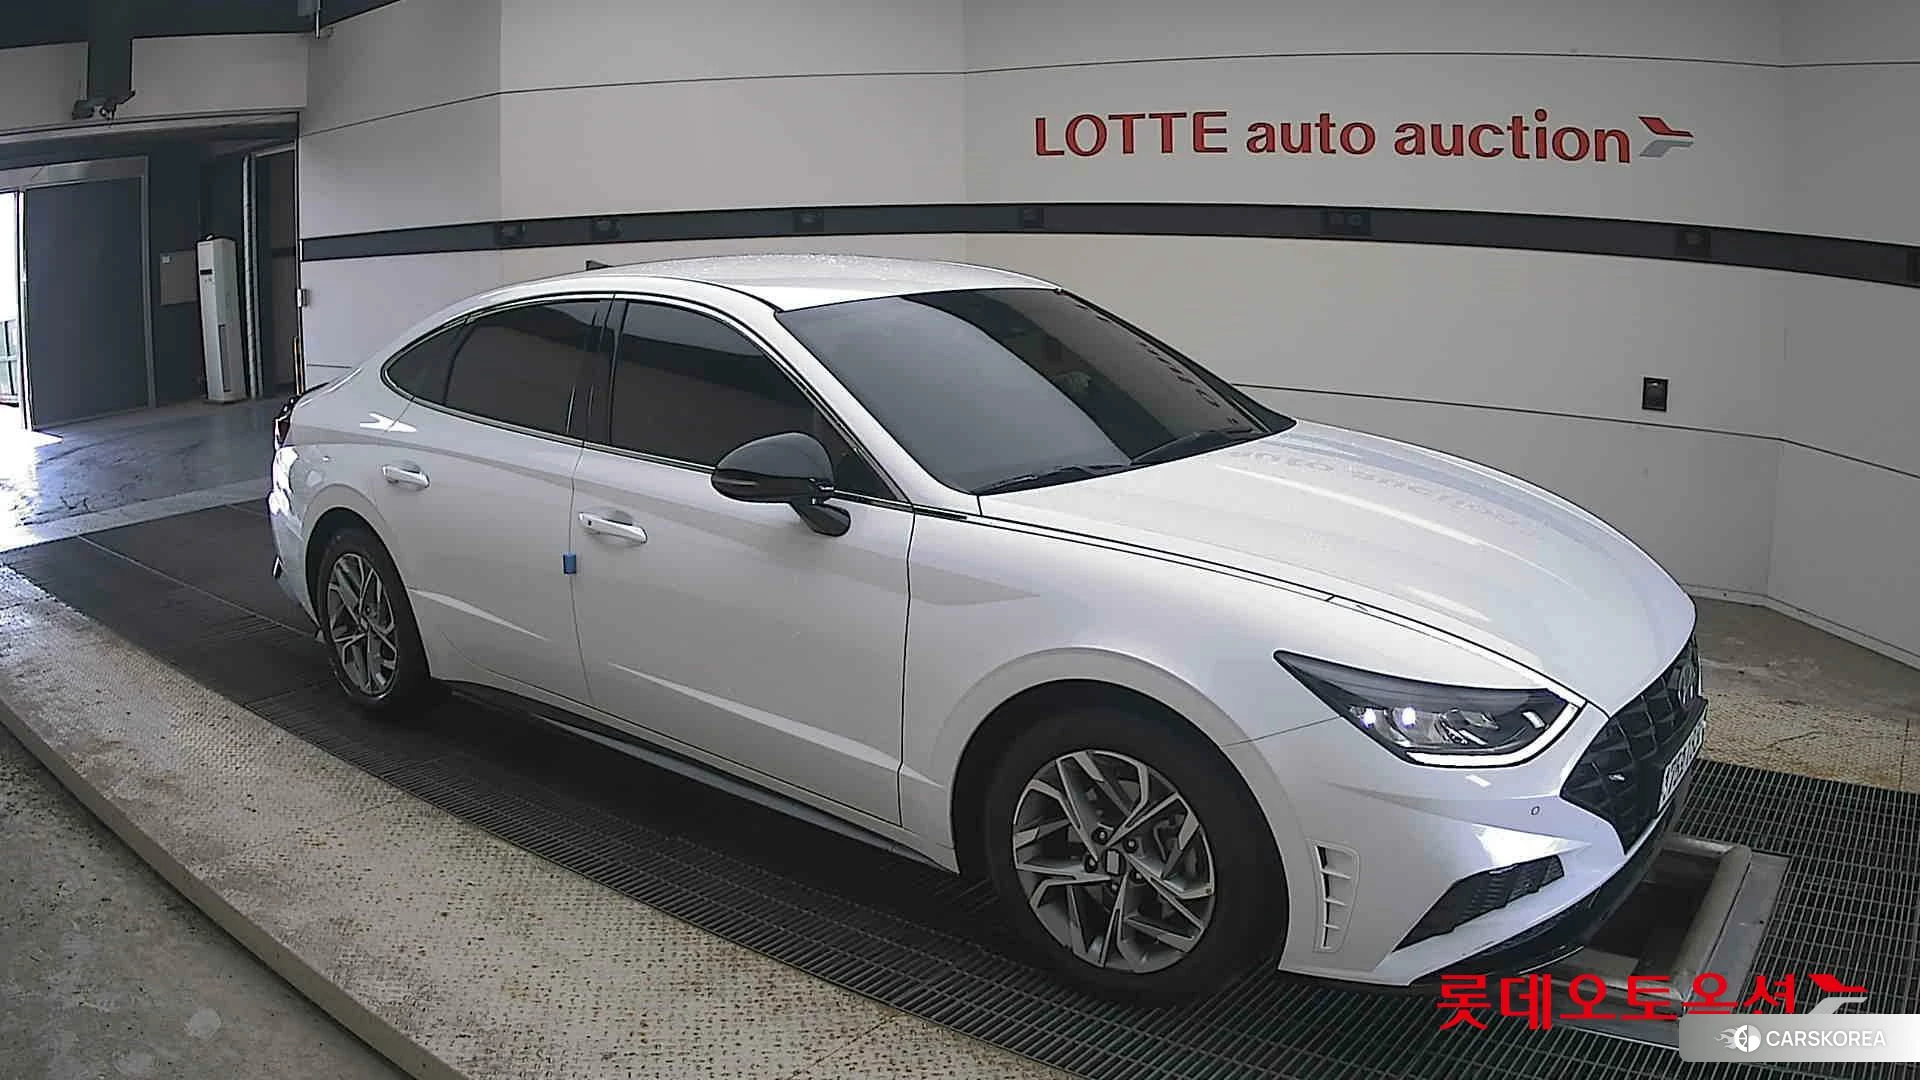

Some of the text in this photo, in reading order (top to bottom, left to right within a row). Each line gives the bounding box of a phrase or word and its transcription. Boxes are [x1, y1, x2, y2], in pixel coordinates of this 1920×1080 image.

[1034, 108, 1632, 164] LOTTE auto auction
